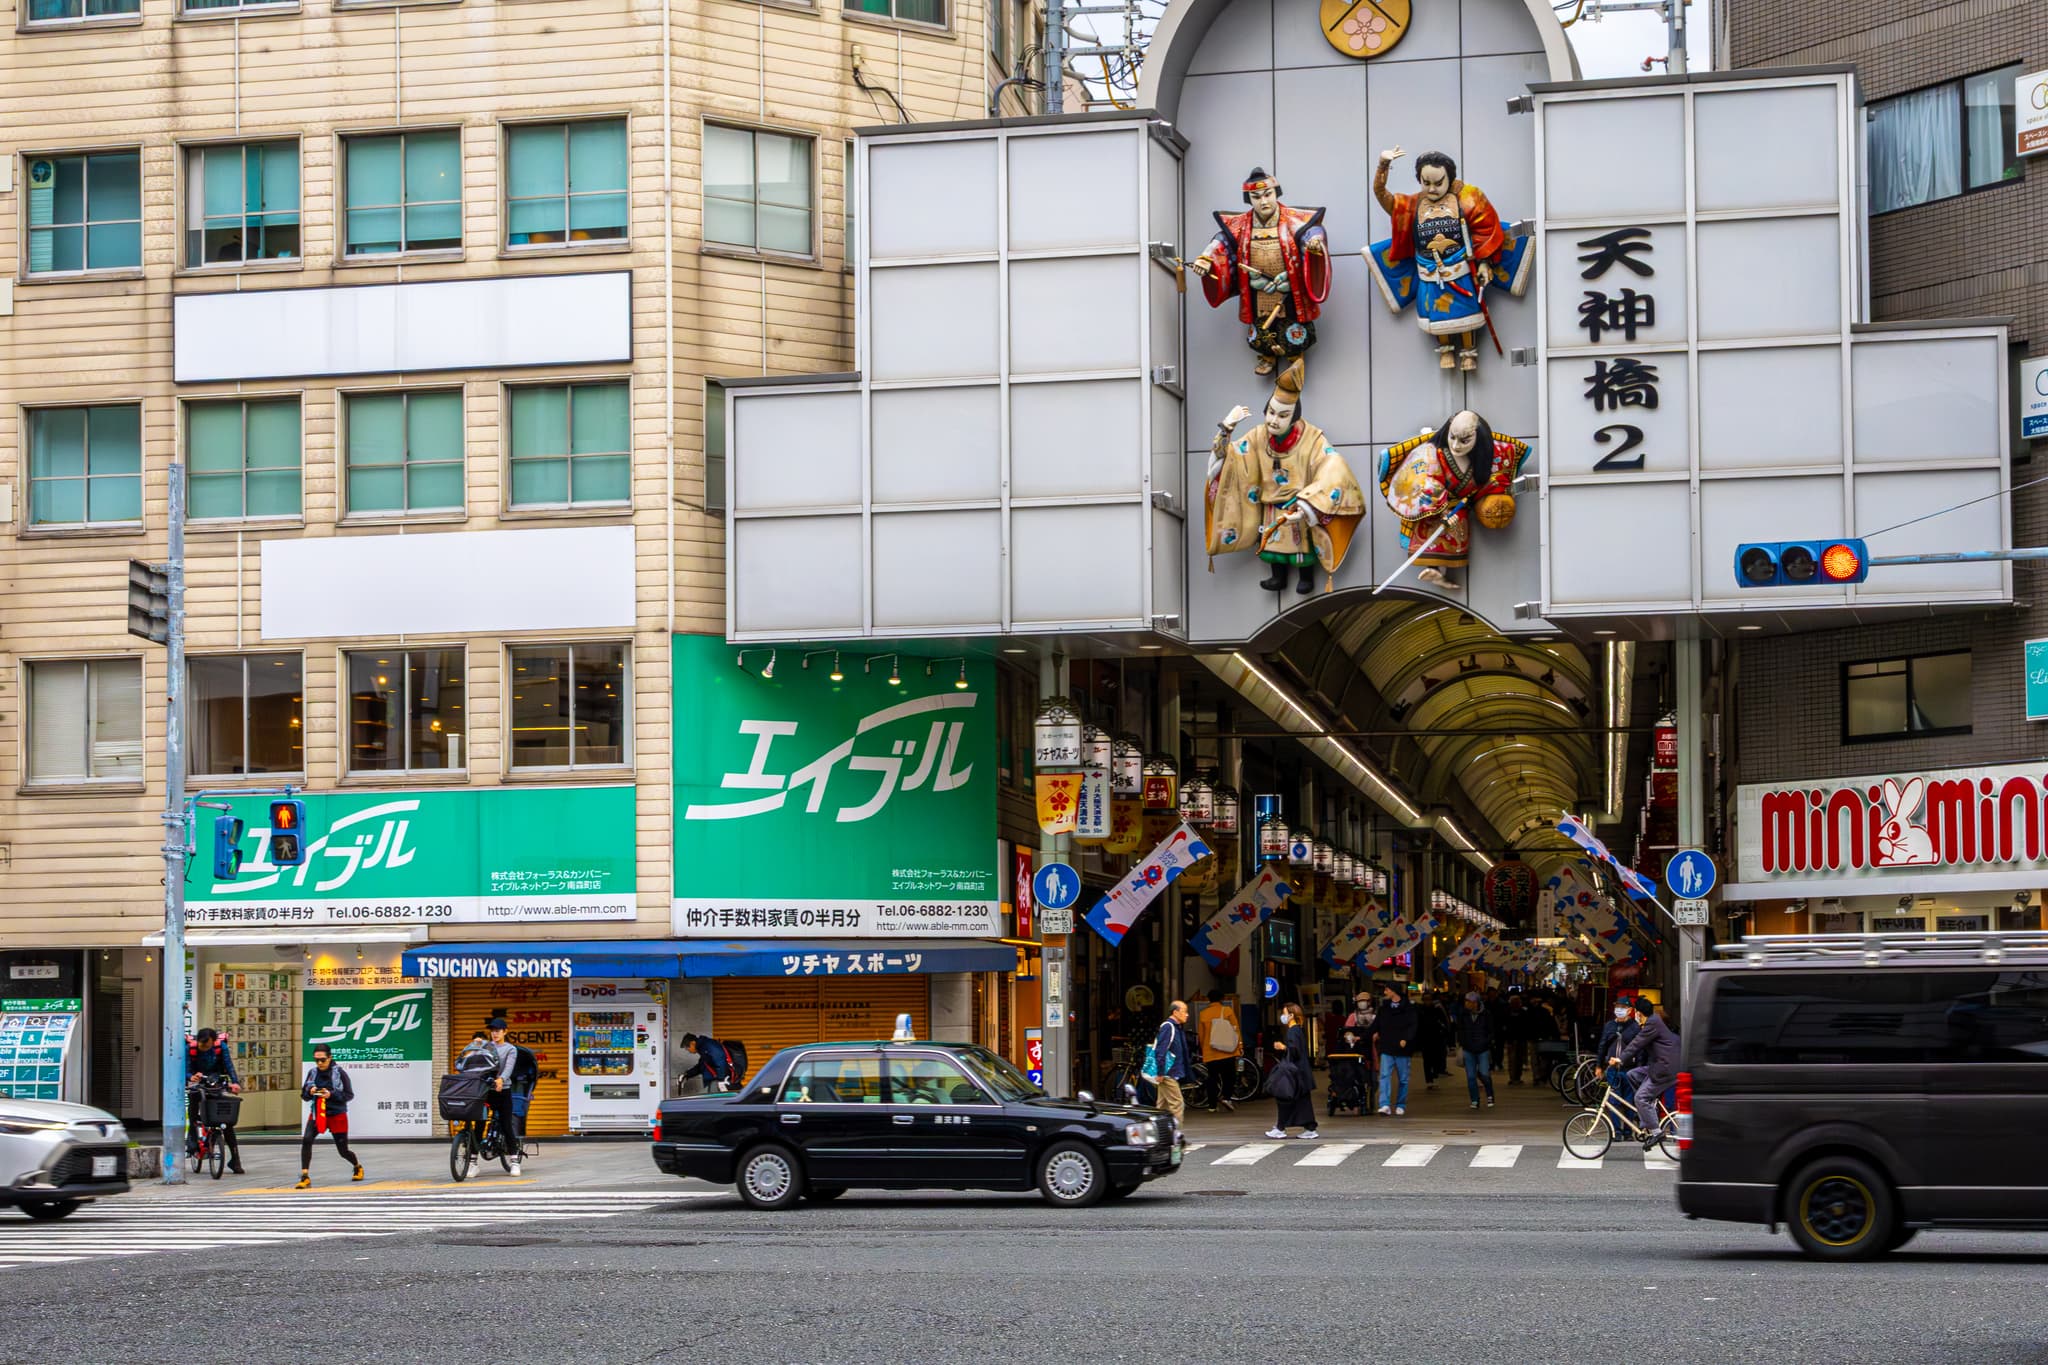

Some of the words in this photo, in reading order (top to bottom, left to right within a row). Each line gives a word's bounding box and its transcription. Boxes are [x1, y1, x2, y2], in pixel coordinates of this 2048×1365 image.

[1578, 227, 1659, 473] 天神橋2
[685, 692, 980, 823] エイブル
[1037, 747, 1079, 761] ツチヤスポーツ
[1147, 791, 1168, 801] 王将
[184, 906, 315, 921] 仲介手数料家賃の半月分
[327, 904, 453, 920] Tel.06-6882-1230
[488, 904, 627, 917] http://www.able-mm.com
[686, 907, 861, 928] 仲介手数料家賃の半月分
[876, 904, 988, 917] Tel.06-6882-1230
[876, 920, 989, 932] http://www.able-mm.com
[417, 957, 499, 978] TSUCHIYA
[506, 957, 573, 978] SPORTS
[783, 954, 840, 975] ツチヤ
[848, 953, 922, 973] スポーツ
[580, 986, 616, 998] DyDo
[309, 993, 426, 1044] エイブル
[508, 1031, 564, 1044] SCENTE
